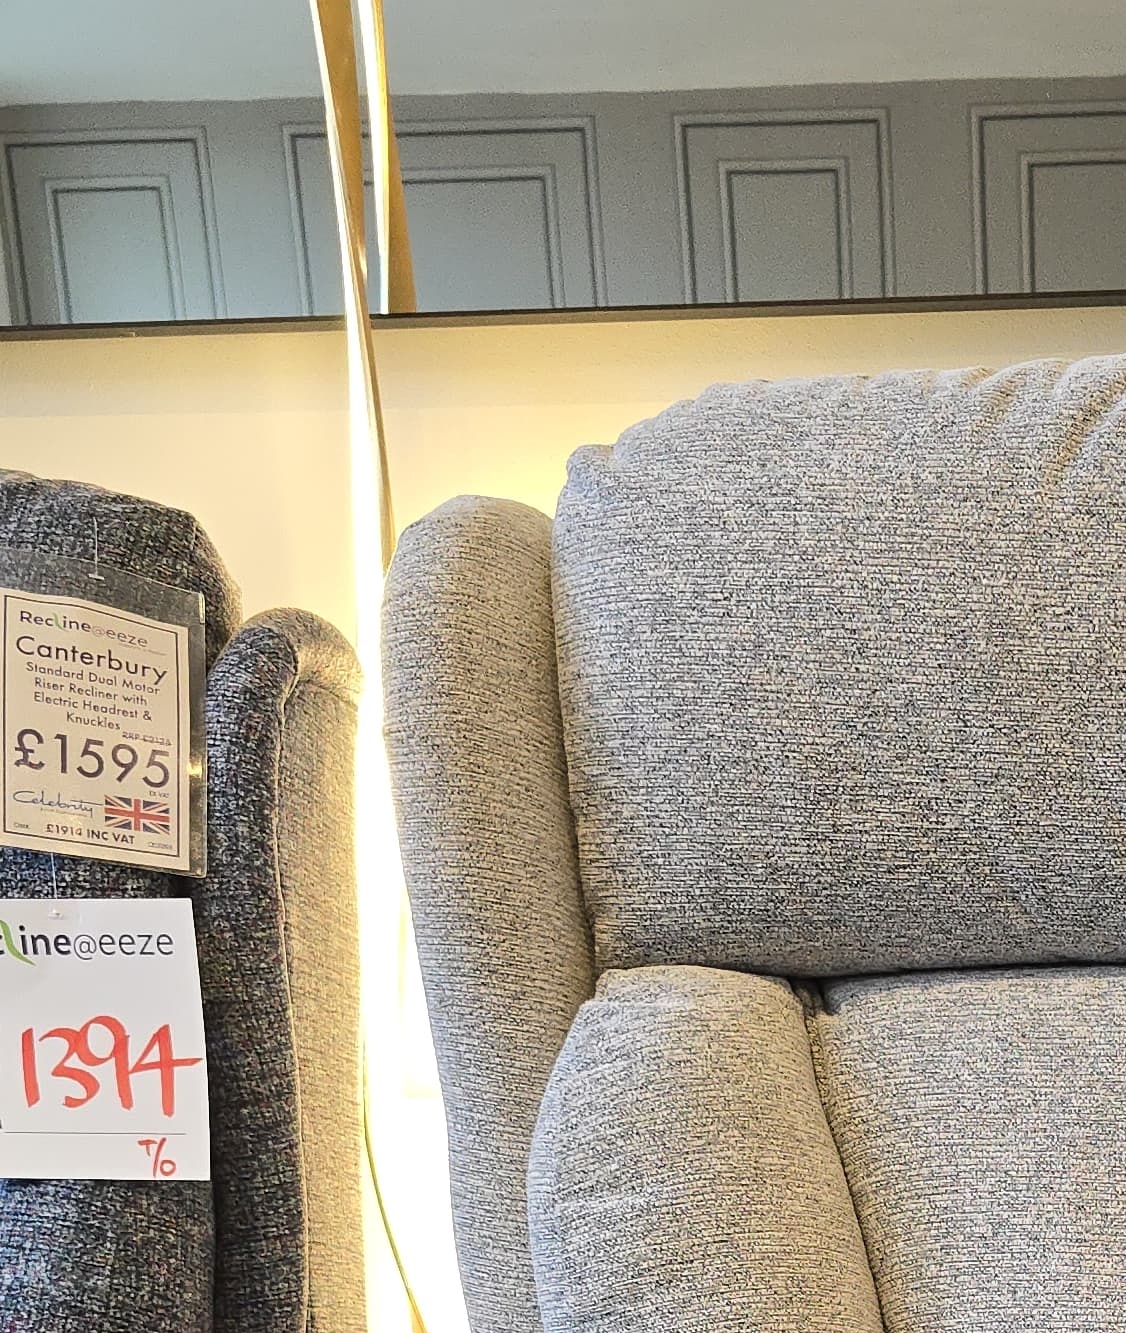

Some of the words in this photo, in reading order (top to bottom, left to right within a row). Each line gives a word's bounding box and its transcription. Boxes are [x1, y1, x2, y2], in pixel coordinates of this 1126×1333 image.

[20, 611, 148, 647] Recline@eeze
[16, 636, 168, 685] Canterbury
[26, 661, 83, 681] Standard
[88, 672, 118, 687] Dual
[122, 678, 160, 695] Motor
[34, 677, 65, 692] Riser
[69, 683, 118, 701] Recliner
[123, 694, 148, 706] with
[34, 691, 78, 709] Electric
[83, 702, 138, 719] Headrest
[143, 710, 152, 721] &
[66, 712, 120, 730] Knuckles
[14, 728, 170, 788] £1595
[13, 790, 104, 818] Celebrity
[86, 828, 108, 842] INC
[112, 832, 135, 845] VAT
[22, 1015, 203, 1118] 1394
